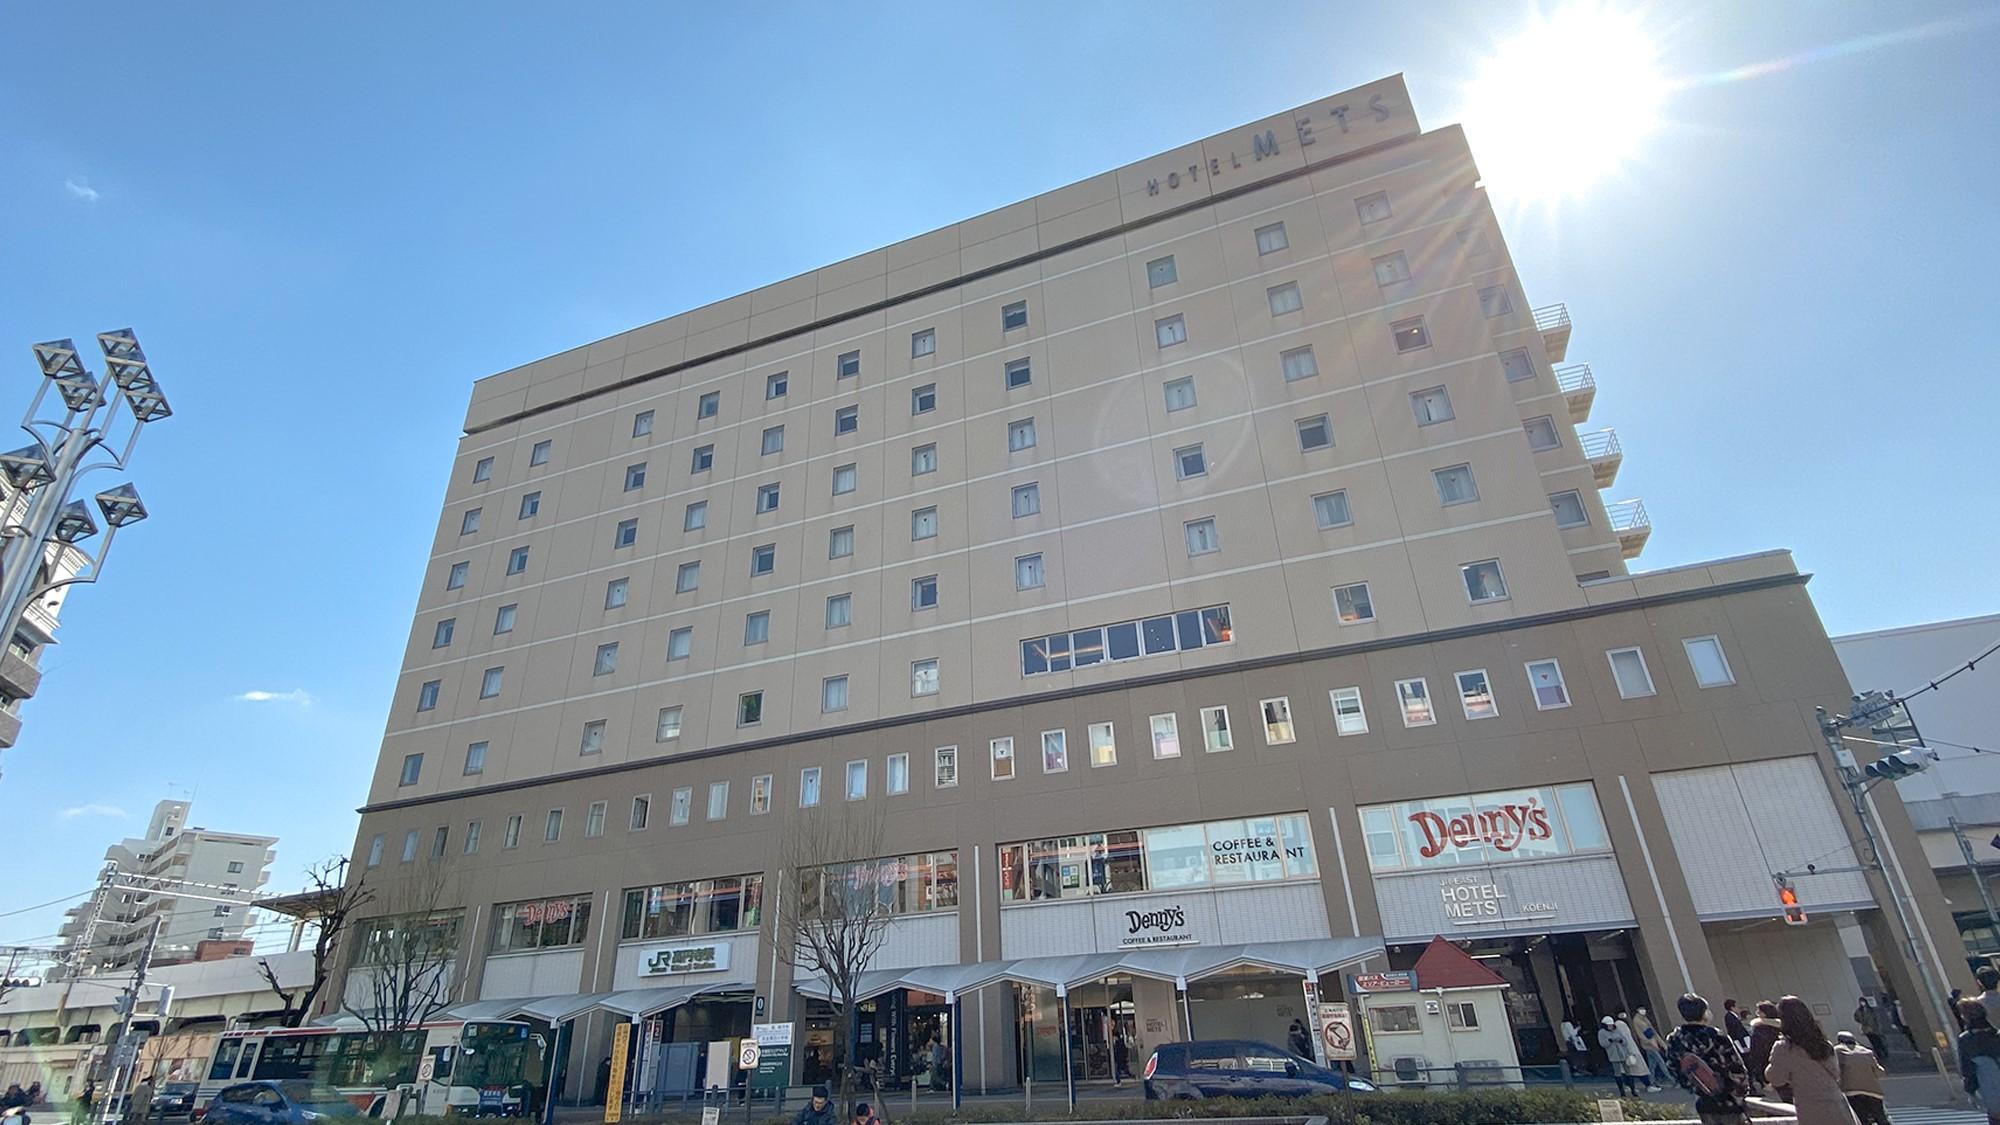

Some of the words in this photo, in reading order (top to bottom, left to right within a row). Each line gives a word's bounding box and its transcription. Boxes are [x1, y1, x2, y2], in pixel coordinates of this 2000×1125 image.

[1146, 152, 1242, 197] HOTEL
[1253, 94, 1390, 162] METS
[1408, 797, 1552, 858] Denny's
[1213, 838, 1261, 851] COFFEE
[1265, 837, 1275, 847] &
[1214, 847, 1305, 865] RESTAURANT
[1441, 884, 1507, 902] HOTEL
[1445, 900, 1498, 918] METS
[1522, 901, 1559, 913] KOENJI
[1125, 905, 1185, 934] Denny's
[1123, 937, 1146, 945] COFFEE
[1152, 934, 1192, 943] RESTAURANT
[648, 951, 671, 968] JR
